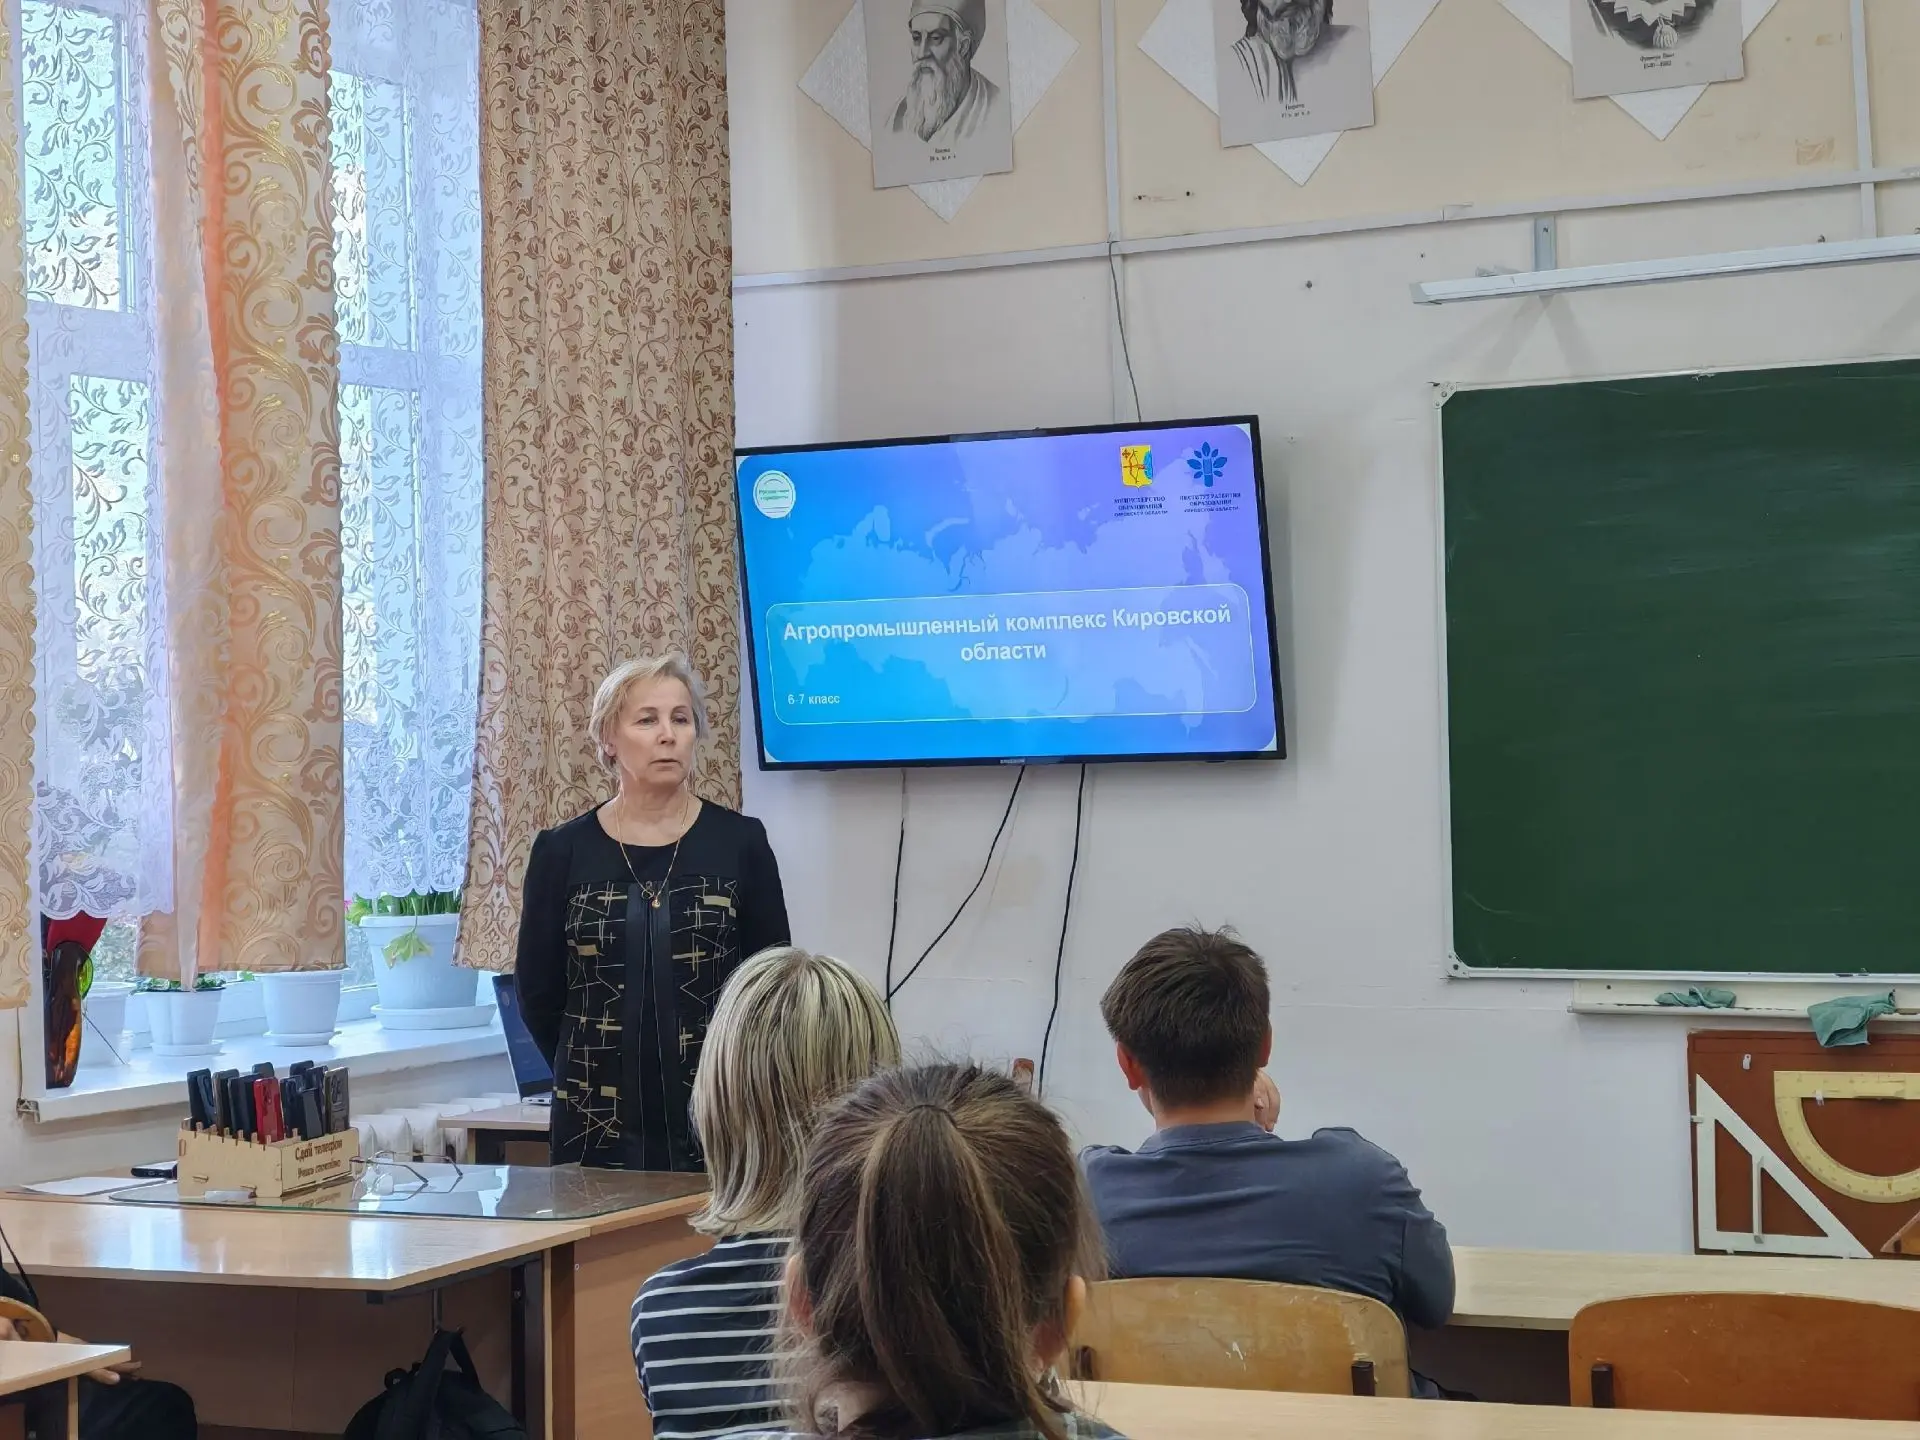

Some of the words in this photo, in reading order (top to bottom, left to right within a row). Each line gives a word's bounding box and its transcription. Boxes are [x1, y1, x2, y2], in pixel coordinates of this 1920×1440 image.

[784, 614, 999, 644] Агропромышленный
[1006, 613, 1107, 632] комплекс
[1112, 603, 1231, 631] Кировской
[960, 642, 1047, 662] области
[787, 694, 805, 705] 6-7
[808, 694, 841, 705] класс
[295, 1143, 313, 1161] Сдай
